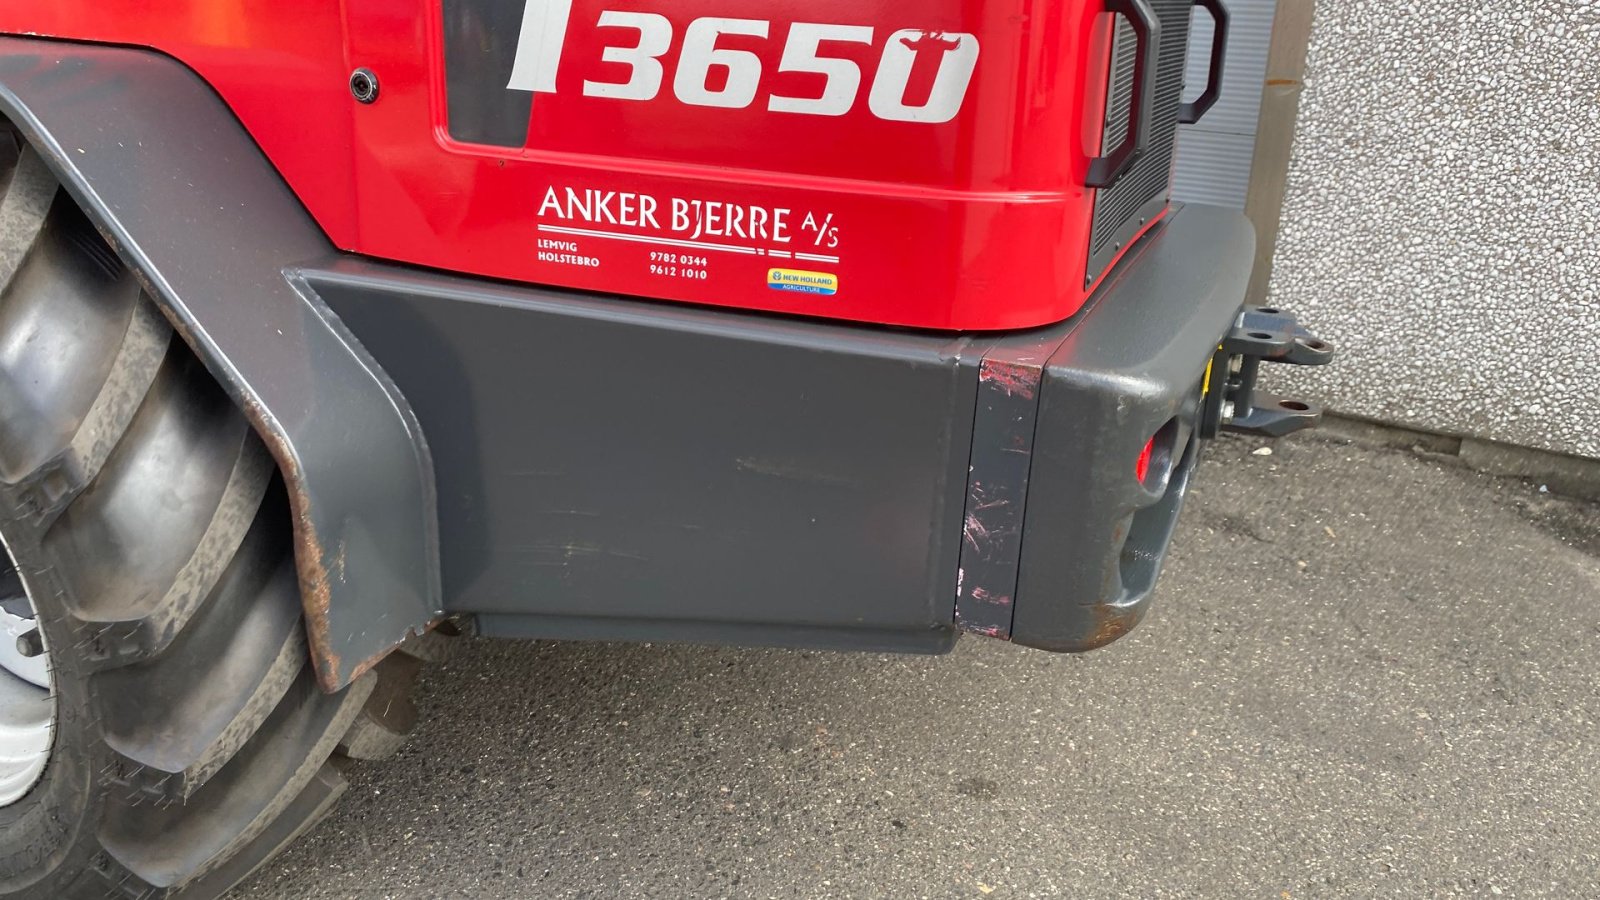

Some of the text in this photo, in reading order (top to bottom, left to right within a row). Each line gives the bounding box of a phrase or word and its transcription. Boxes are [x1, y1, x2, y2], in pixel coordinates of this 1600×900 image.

[583, 10, 980, 124] 3650
[537, 185, 840, 249] ANKER BJERRE A/S
[537, 239, 578, 253] LEMVIG
[537, 252, 600, 267] HOLSTEBRO
[650, 251, 708, 267] 9782 0344
[650, 264, 708, 280] 9612 1010
[783, 274, 833, 286] NEW HOLLAND
[782, 284, 821, 293] AGRICULTURE
